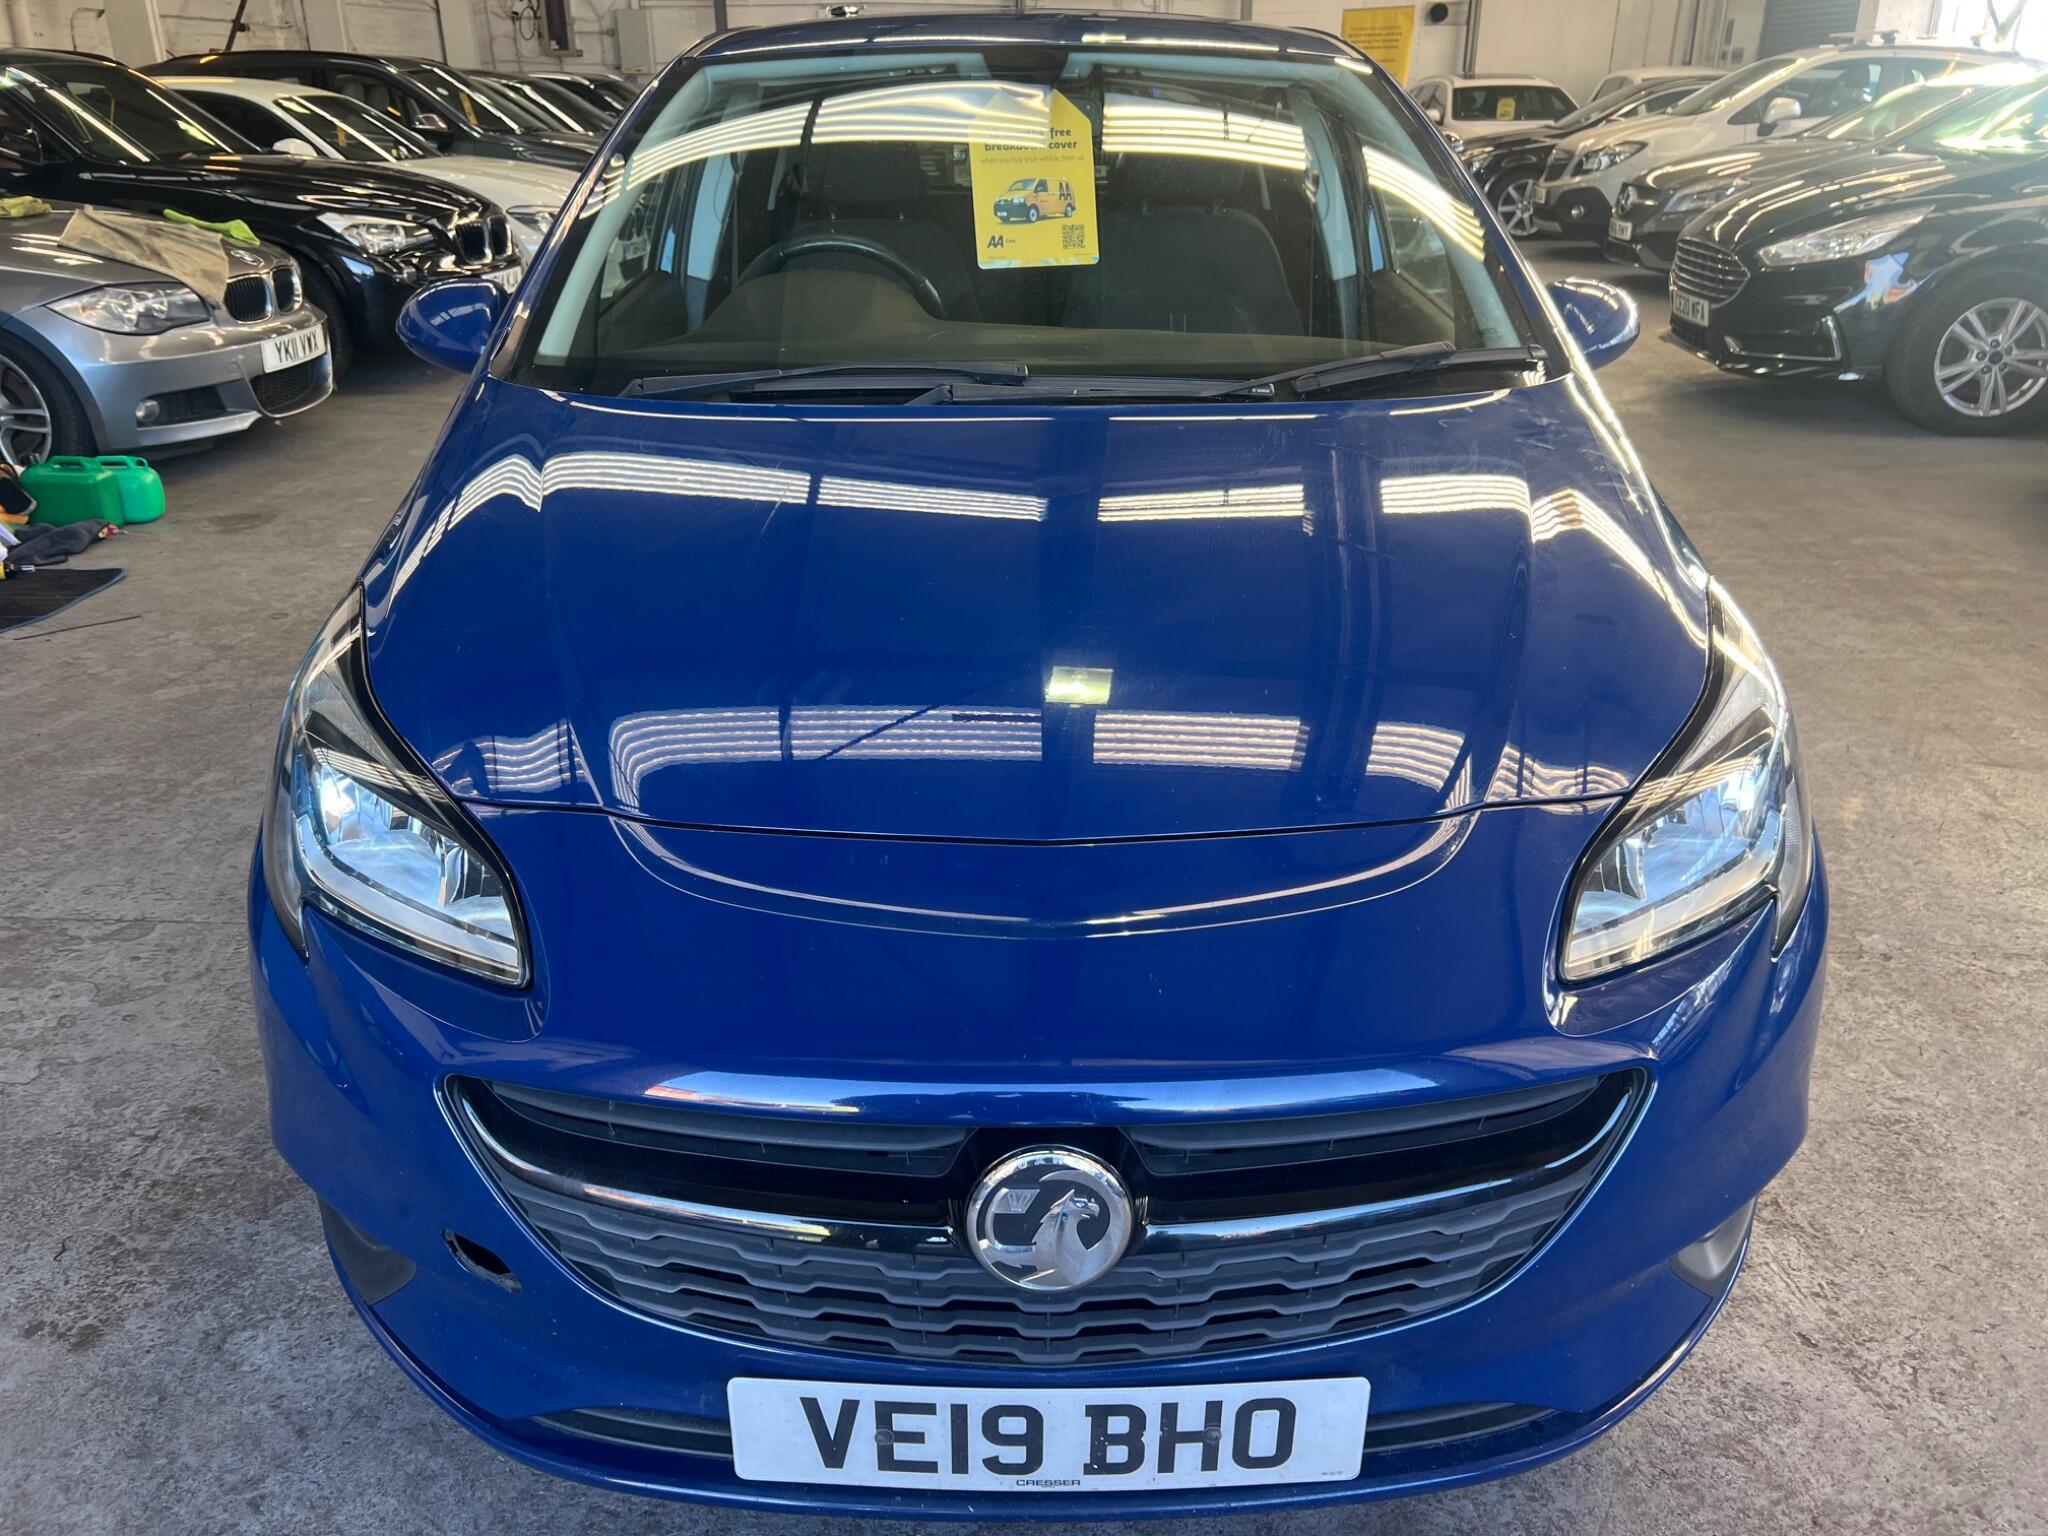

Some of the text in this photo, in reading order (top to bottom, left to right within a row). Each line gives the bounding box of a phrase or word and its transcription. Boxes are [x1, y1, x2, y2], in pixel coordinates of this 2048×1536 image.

[1049, 127, 1072, 139] free
[1048, 141, 1077, 149] cover
[1059, 182, 1072, 200] AA
[987, 235, 1004, 248] AA
[274, 337, 300, 363] YK11
[799, 1396, 1297, 1476] VE19 BHO
